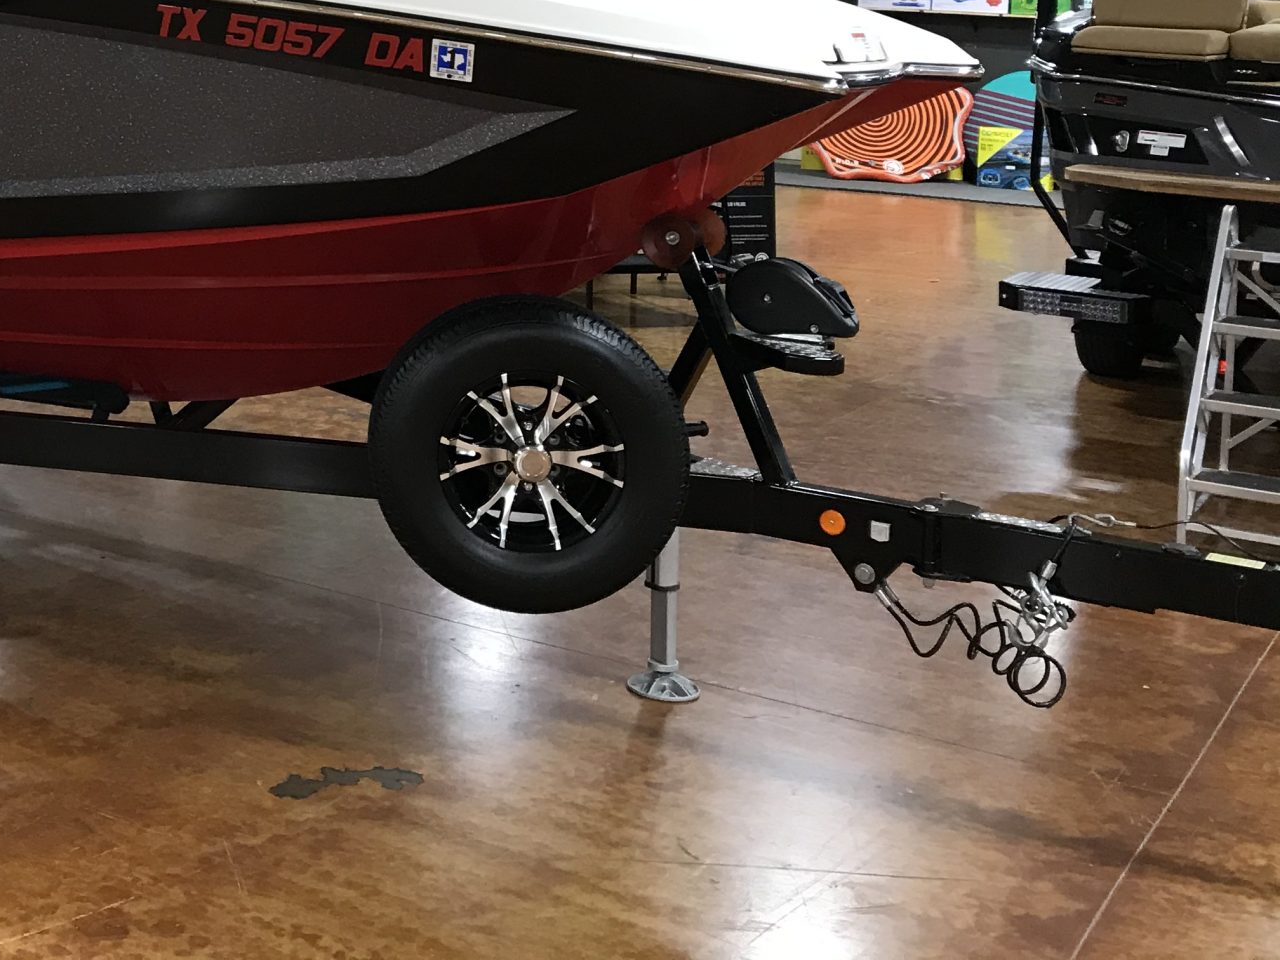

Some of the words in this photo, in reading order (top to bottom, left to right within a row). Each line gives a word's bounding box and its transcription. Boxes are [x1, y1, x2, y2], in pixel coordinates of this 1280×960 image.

[157, 4, 206, 41] TX
[225, 13, 345, 58] 5057
[364, 33, 424, 72] DA
